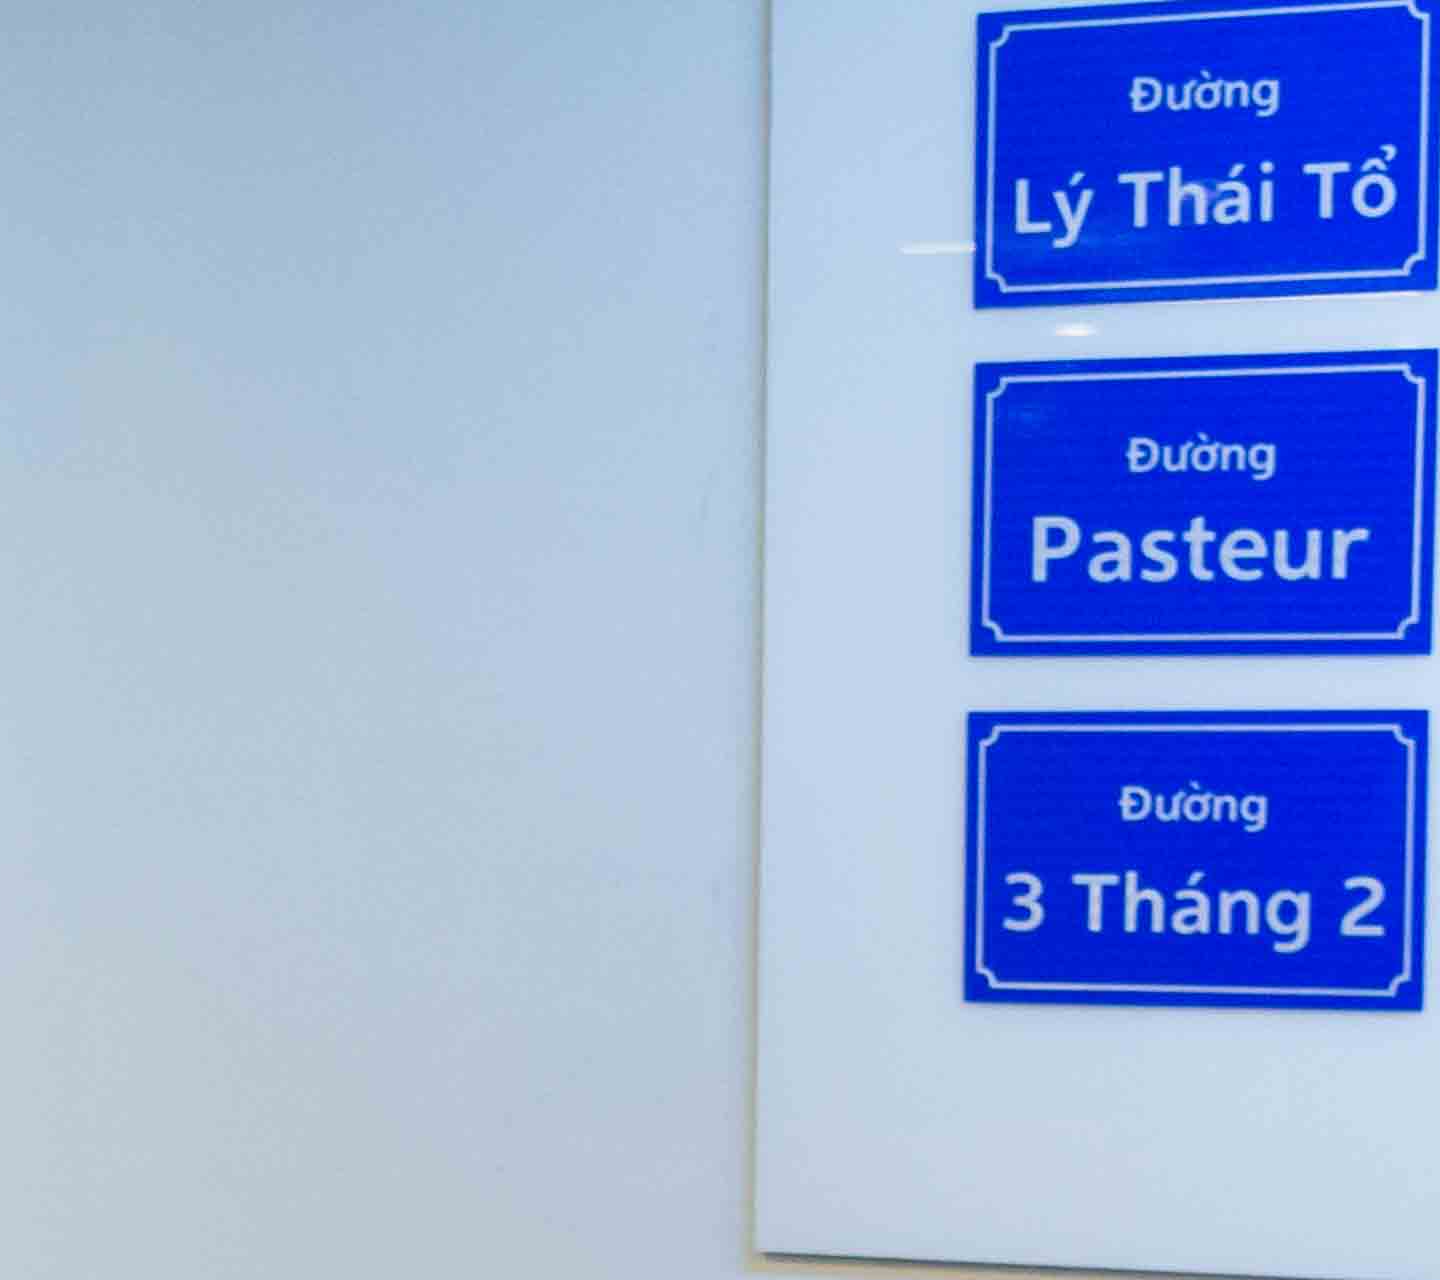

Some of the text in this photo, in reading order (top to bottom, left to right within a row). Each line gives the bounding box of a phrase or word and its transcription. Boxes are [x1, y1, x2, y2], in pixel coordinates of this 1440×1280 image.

[1130, 70, 1280, 117] Đường
[1014, 143, 1398, 248] Lý Thái Tổ
[1125, 431, 1278, 481] Đường
[1031, 514, 1371, 584] Pasteur
[1118, 780, 1269, 833] Đường
[1002, 869, 1386, 954] 3 Tháng 2
